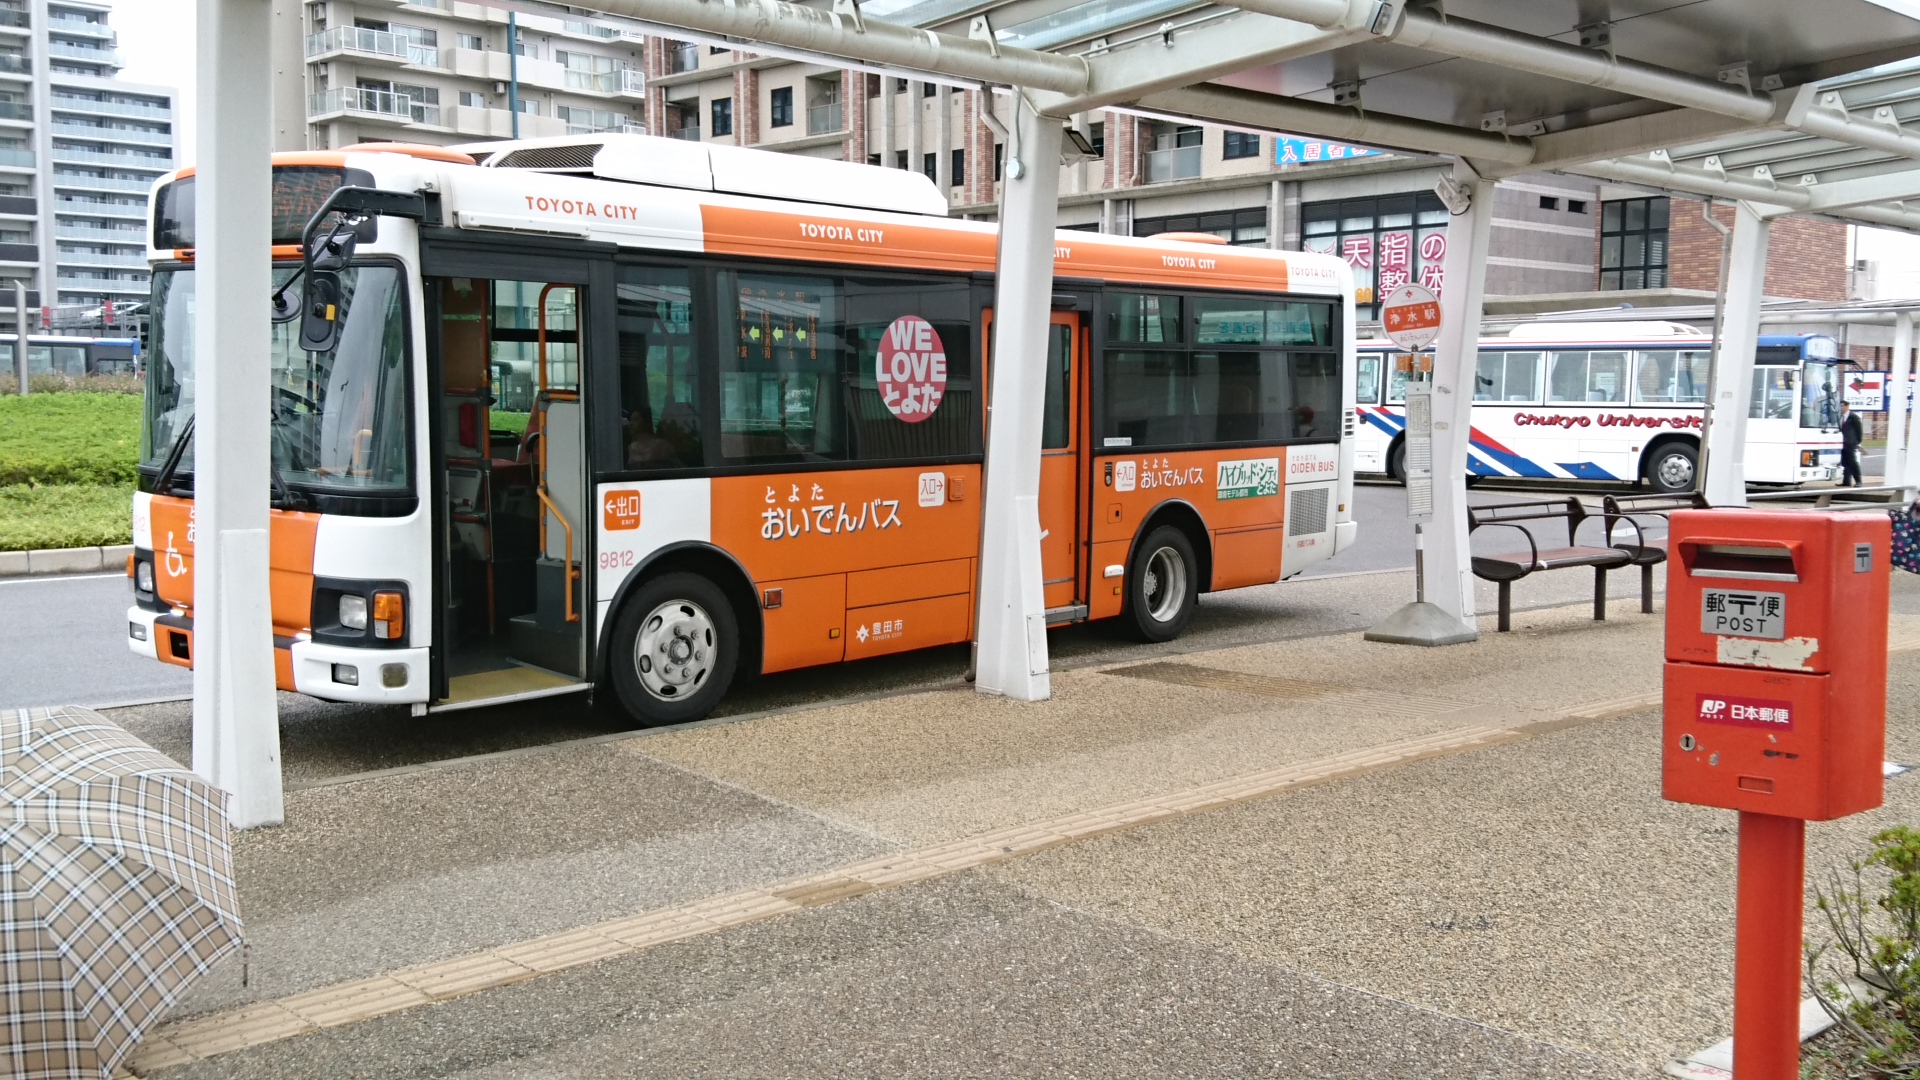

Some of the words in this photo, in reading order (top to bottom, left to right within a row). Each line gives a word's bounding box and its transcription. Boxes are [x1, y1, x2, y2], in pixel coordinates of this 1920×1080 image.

[525, 196, 597, 216] TOYOTA
[603, 204, 637, 220] CITY
[799, 223, 853, 241] TOYOTA
[857, 228, 884, 243] CITY
[1161, 255, 1196, 269] TOYOTA
[1198, 258, 1216, 270] CITY
[1291, 266, 1319, 277] TOYOTA
[1321, 270, 1336, 278] CITY
[1389, 308, 1436, 325] 浄水駅
[889, 320, 933, 351] WE
[876, 352, 947, 382] LOVE
[883, 383, 942, 414] とよた
[1866, 396, 1881, 406] 2F
[1514, 412, 1591, 429] Chukyo
[1142, 458, 1169, 469] とよた
[1291, 463, 1316, 474] OIDEN
[1318, 461, 1335, 472] BUS
[1122, 467, 1134, 481] 入口
[1140, 467, 1204, 489] おいでんバス
[765, 483, 824, 503] とよた
[921, 479, 936, 495] 入口
[1257, 481, 1276, 495] とよた
[616, 496, 639, 516] 出口
[761, 498, 902, 540] おいでんバス
[600, 550, 634, 570] 9812
[872, 619, 903, 635] 豊田市
[1716, 616, 1767, 633] POST
[1731, 704, 1789, 723] 日本郵便
